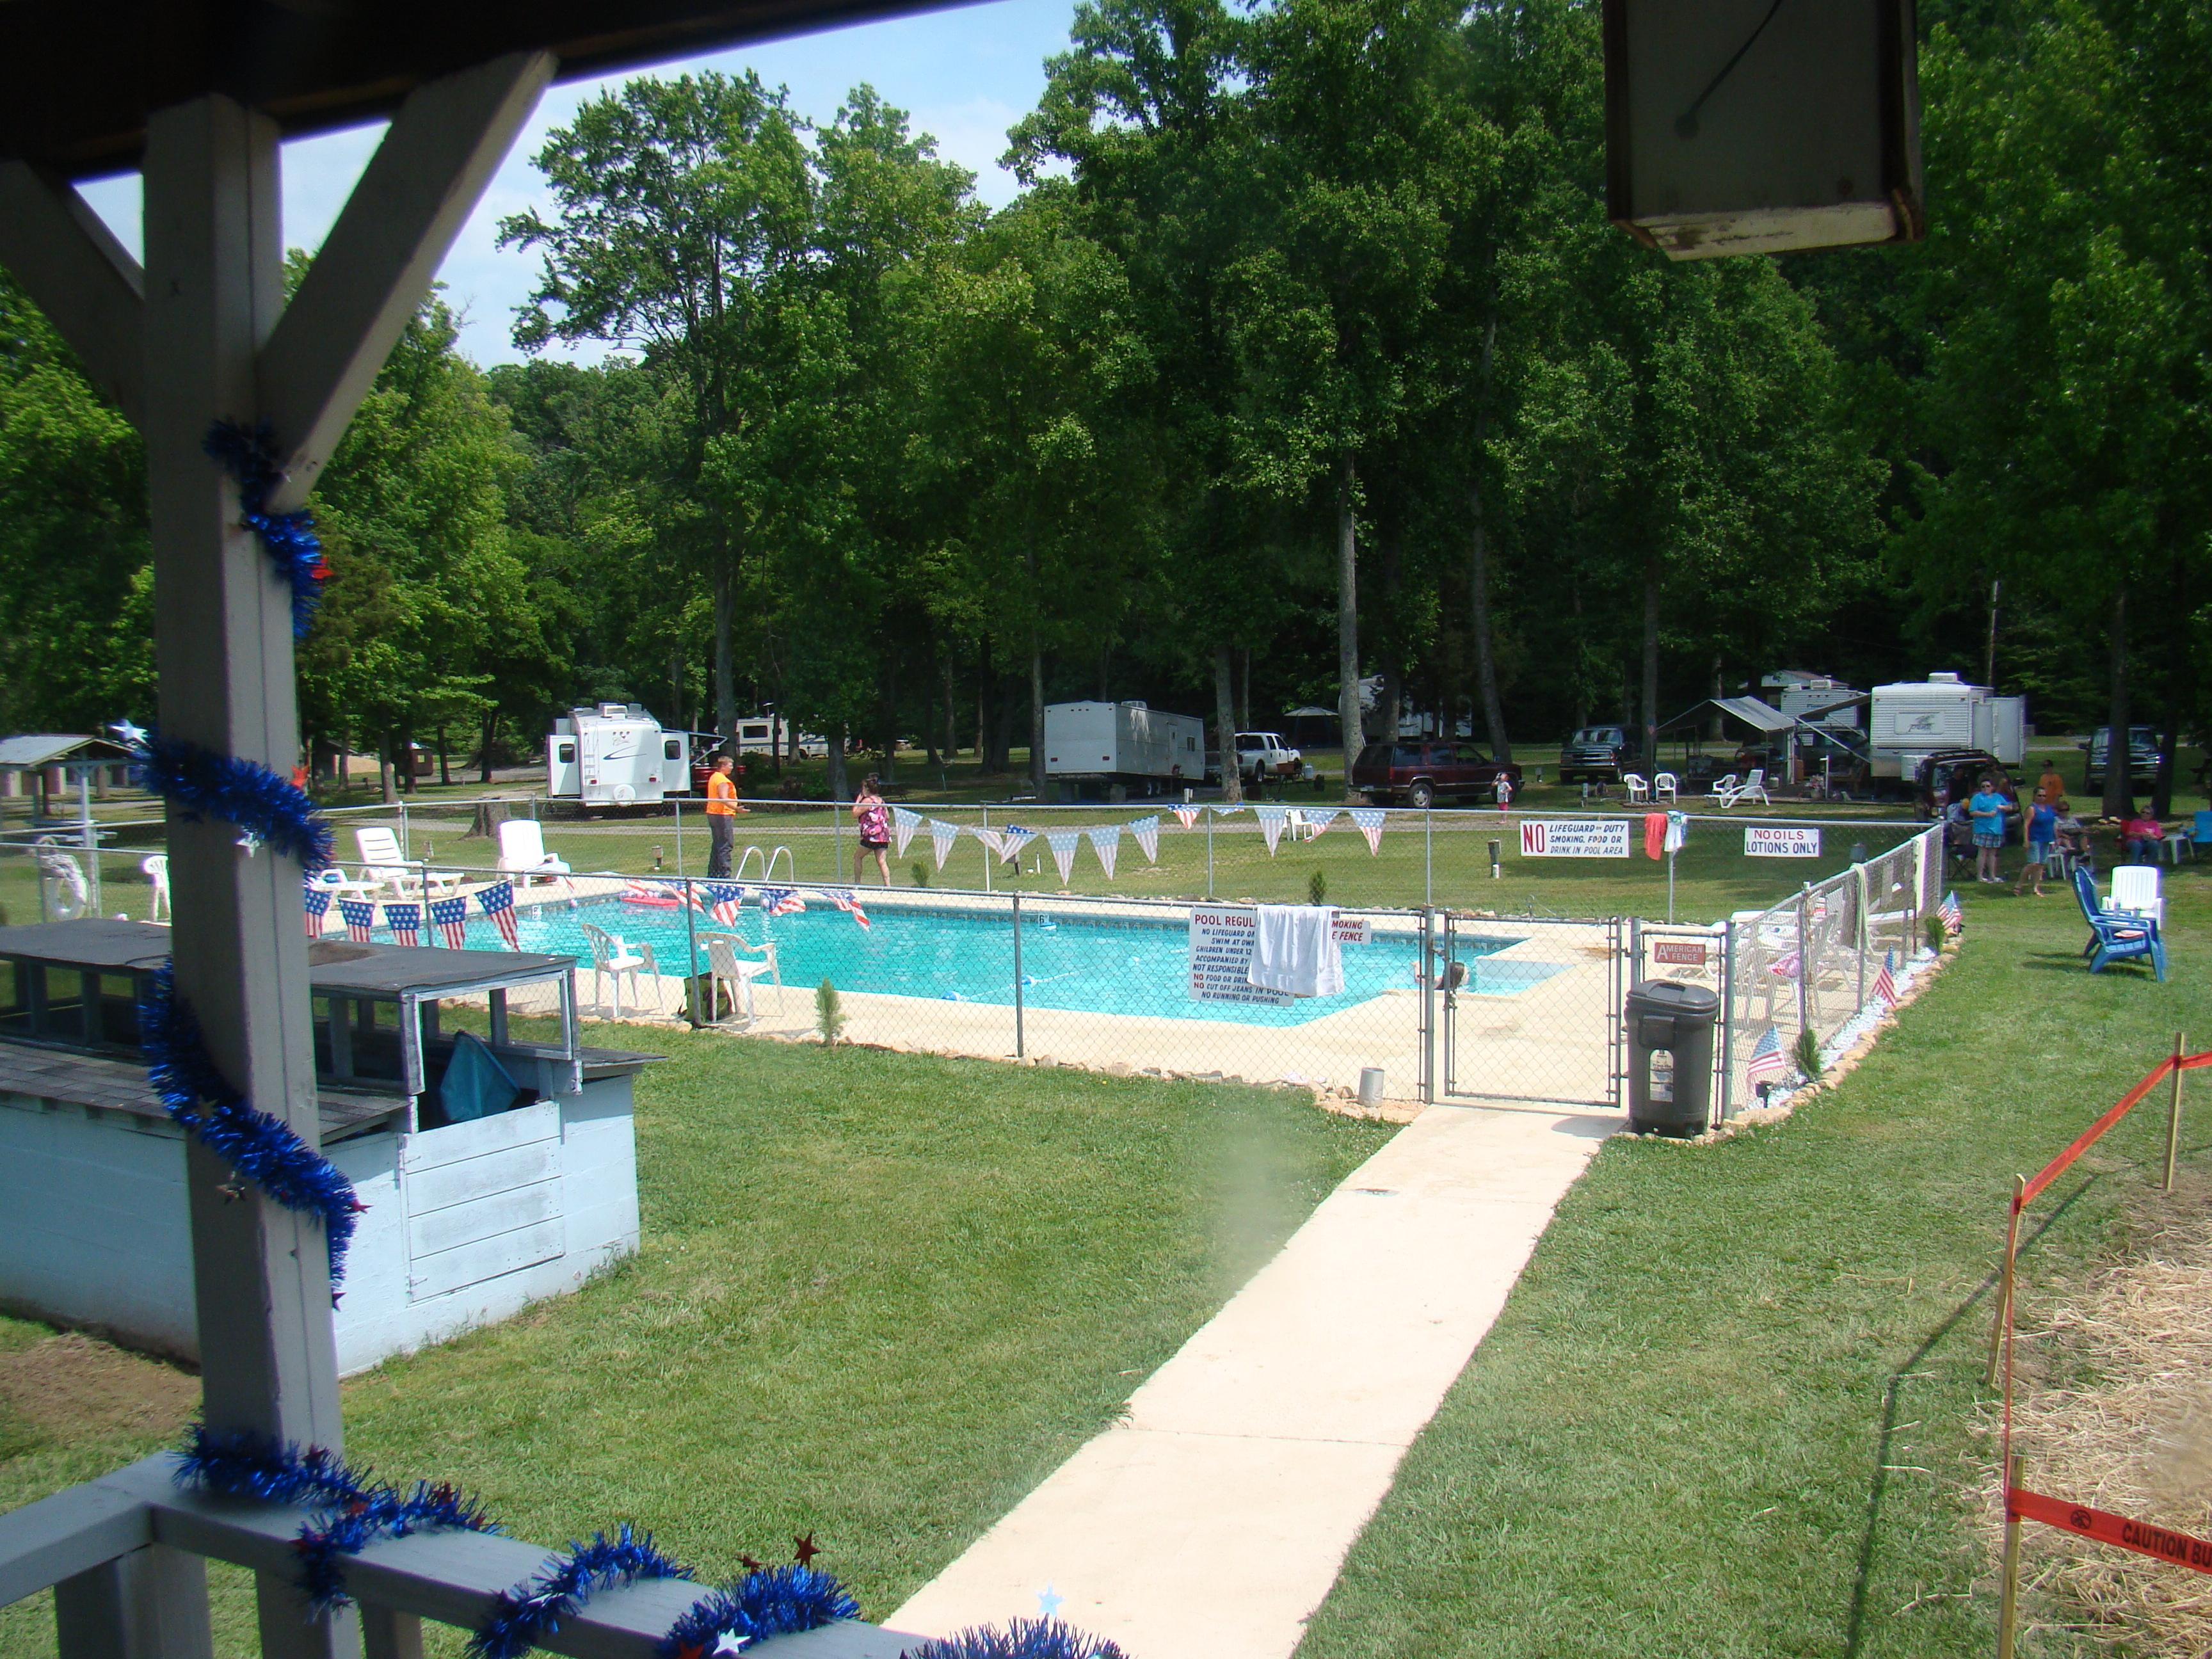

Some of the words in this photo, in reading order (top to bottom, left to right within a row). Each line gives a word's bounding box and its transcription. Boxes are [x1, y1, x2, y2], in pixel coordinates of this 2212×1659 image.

[1549, 824, 1595, 833] LIFEGUARD
[1603, 824, 1625, 833] DUTY
[1523, 824, 1545, 853] NO
[1754, 830, 1770, 839] NO
[1774, 831, 1804, 840] OILS
[1583, 846, 1600, 854] POOL
[1746, 842, 1788, 853] LOTIONS
[1793, 843, 1818, 854] ONLY
[1194, 914, 1222, 926] POOL
[1225, 916, 1256, 927] REGUL
[1212, 929, 1245, 937] LIFEGUARD
[1339, 931, 1363, 942] FENCE
[1196, 945, 1223, 954] CHILDREN
[1225, 947, 1244, 955] UNDER
[1656, 944, 1703, 960] AMERICAN
[1195, 954, 1238, 964] ACCOMPANIED
[1672, 952, 1698, 961] FENCE
[1192, 963, 1206, 972] NOT
[1206, 965, 1249, 974] RESPONSIBLE
[1212, 992, 1240, 1001] RUNNING
[1252, 995, 1279, 1004] PUSHING
[2123, 1523, 2188, 1561] CAUTION
